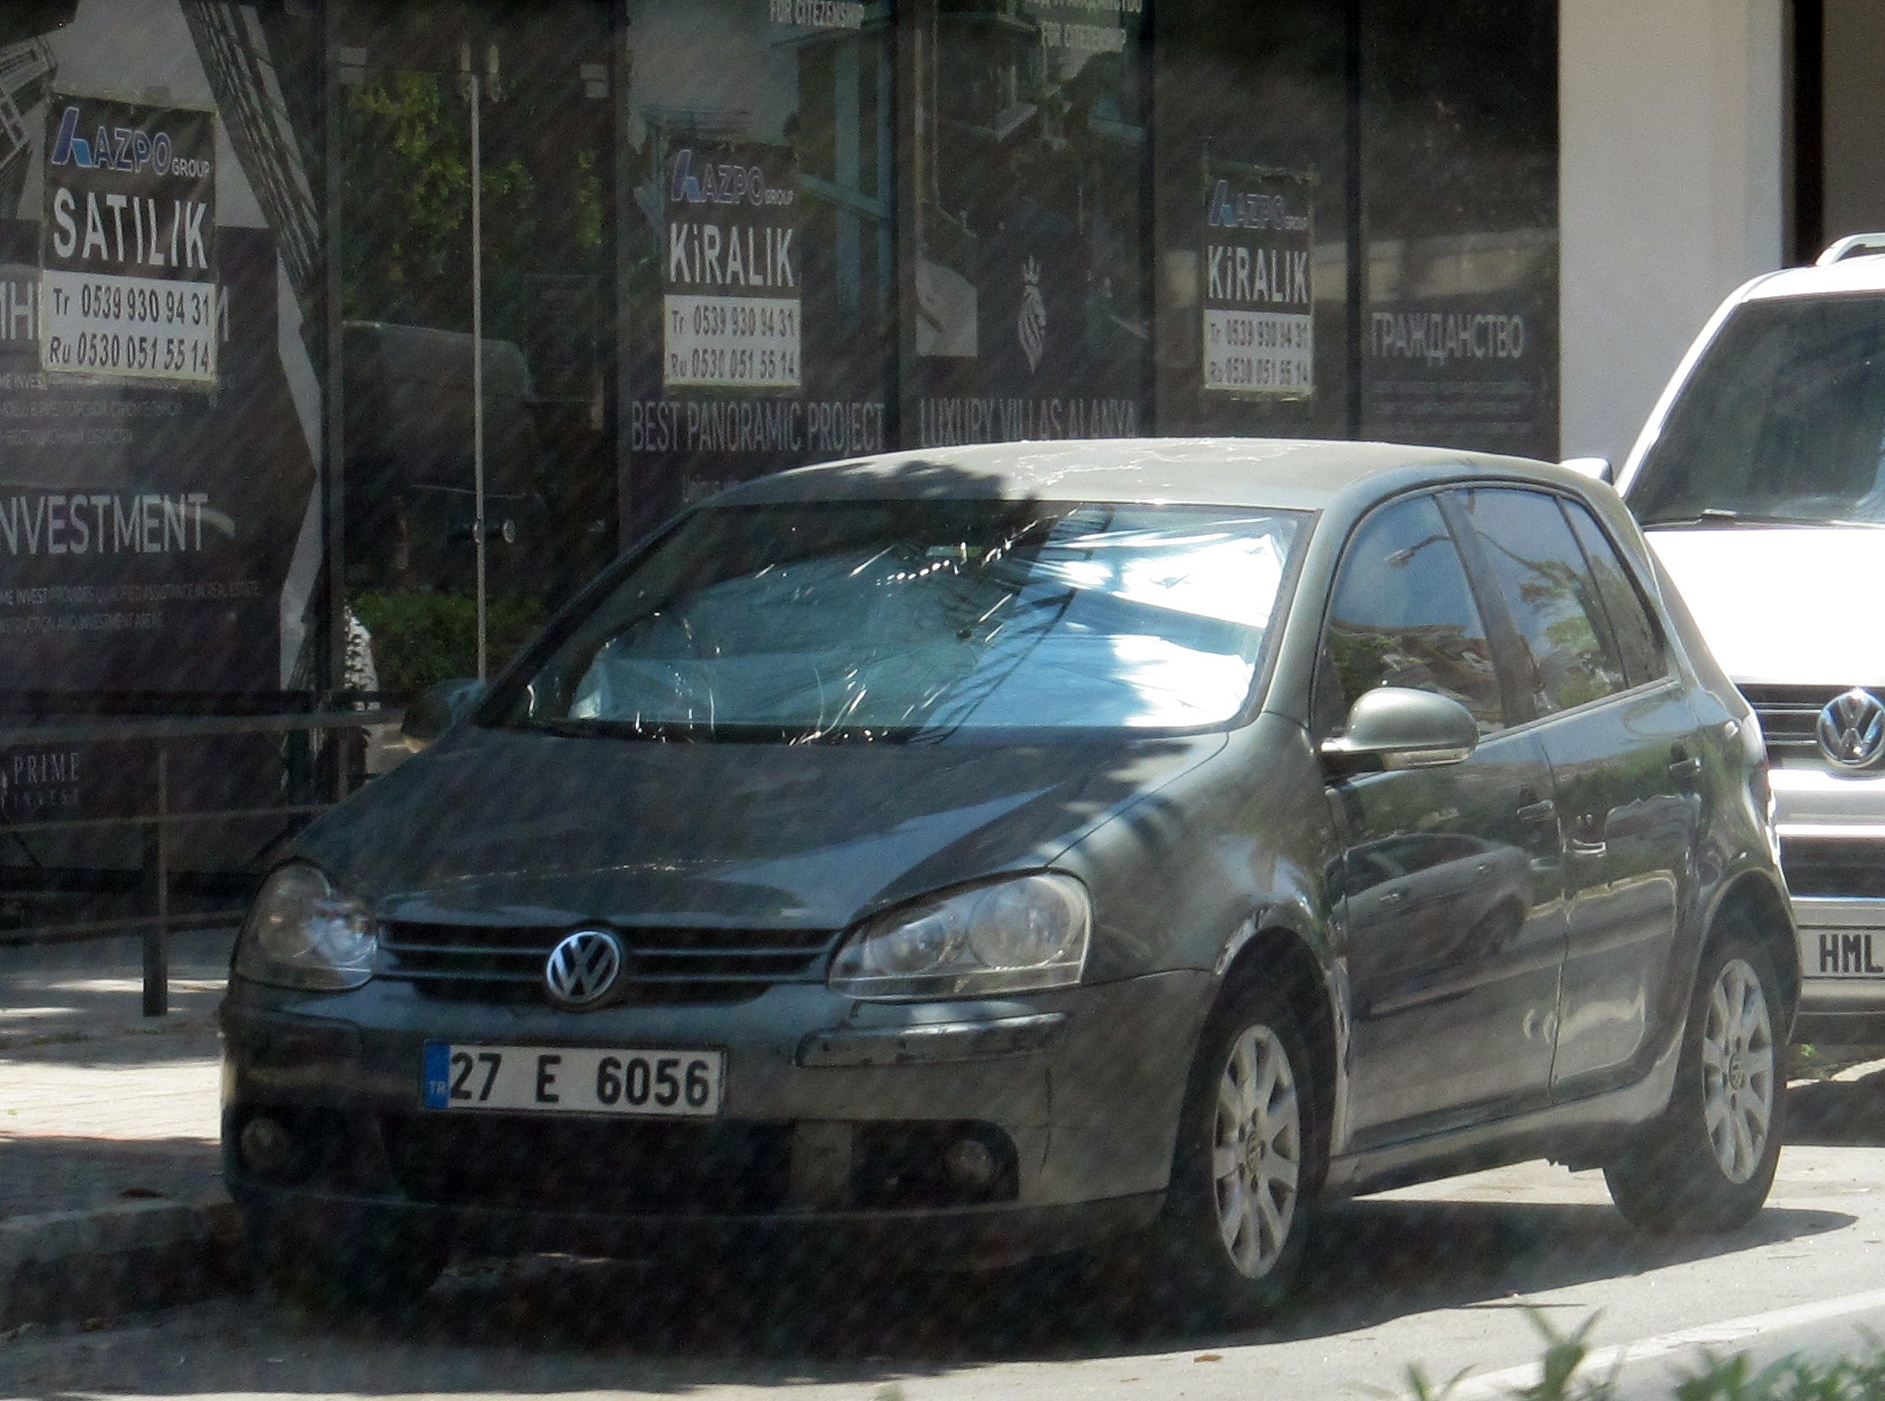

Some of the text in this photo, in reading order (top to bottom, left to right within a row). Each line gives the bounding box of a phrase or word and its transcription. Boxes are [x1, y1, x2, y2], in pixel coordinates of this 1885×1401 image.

[94, 126, 211, 178] AZPO GROUP
[53, 187, 208, 269] SATILIK
[54, 288, 70, 315] Tr
[82, 284, 121, 319] 0539
[127, 287, 159, 323] 930
[167, 290, 185, 324] 94
[192, 292, 209, 326] 31
[50, 332, 208, 373] Ru 0530 051 55 14
[1372, 312, 1523, 366] ГРАЖДАНСТВО
[632, 401, 885, 451] BEST PANORAMIC PROJECT
[14, 752, 79, 784] PRIME
[1818, 934, 1884, 974] HML
[451, 1052, 501, 1101] 27
[536, 1054, 561, 1103] E
[596, 1056, 709, 1107] 6056
